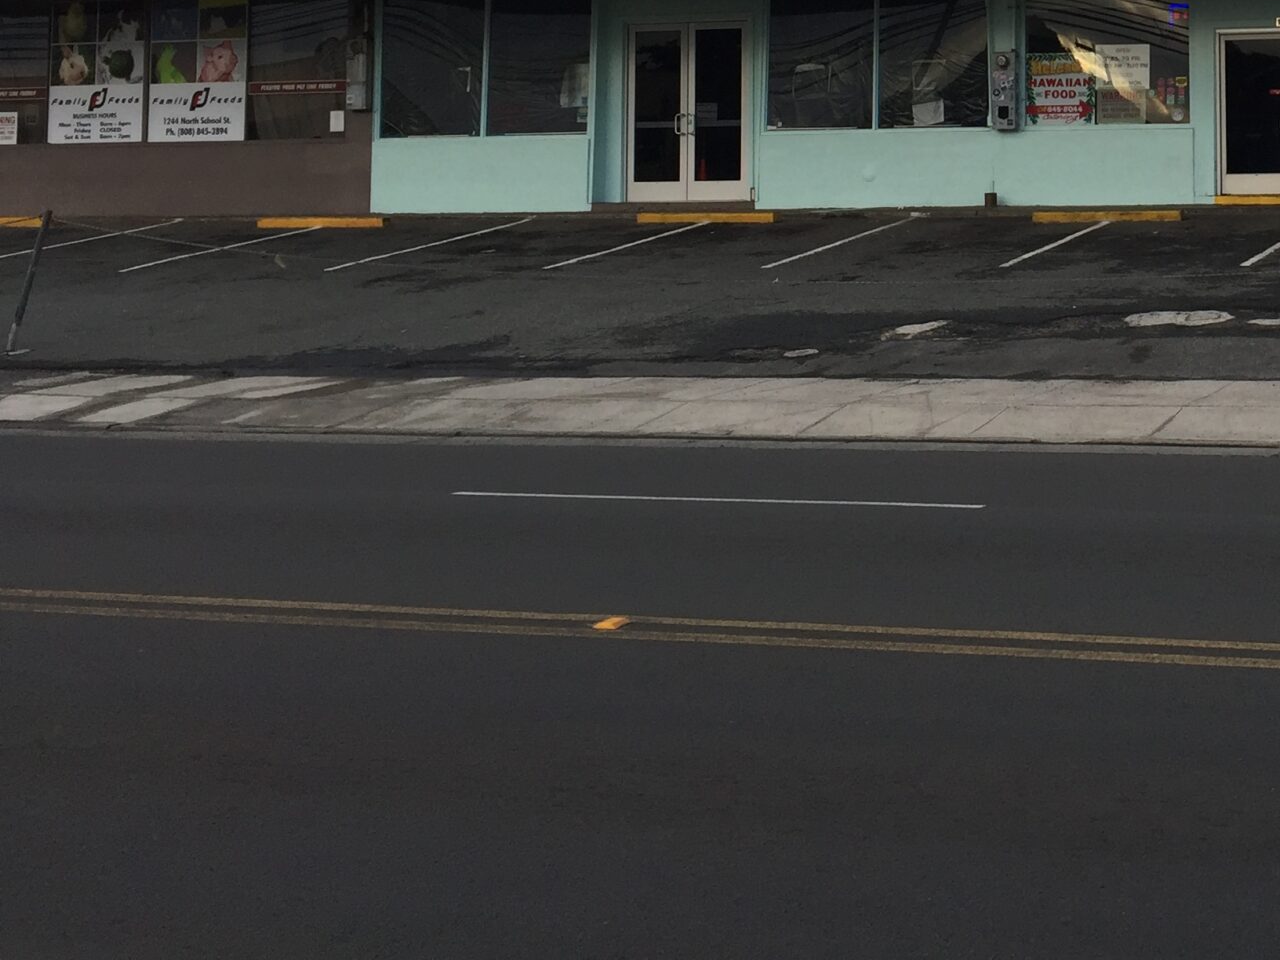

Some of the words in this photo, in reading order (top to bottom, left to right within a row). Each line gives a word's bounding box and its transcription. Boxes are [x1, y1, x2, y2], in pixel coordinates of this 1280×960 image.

[1029, 78, 1091, 87] HAWAIIAN
[1044, 90, 1076, 99] FOOD
[51, 98, 88, 106] Family
[108, 96, 139, 104] Feeds
[152, 97, 188, 106] Family
[210, 96, 242, 104] Feeds
[163, 117, 179, 125] 1244
[181, 116, 199, 124] North
[201, 116, 221, 124] School
[223, 116, 231, 124] St.
[177, 127, 195, 137] (808)
